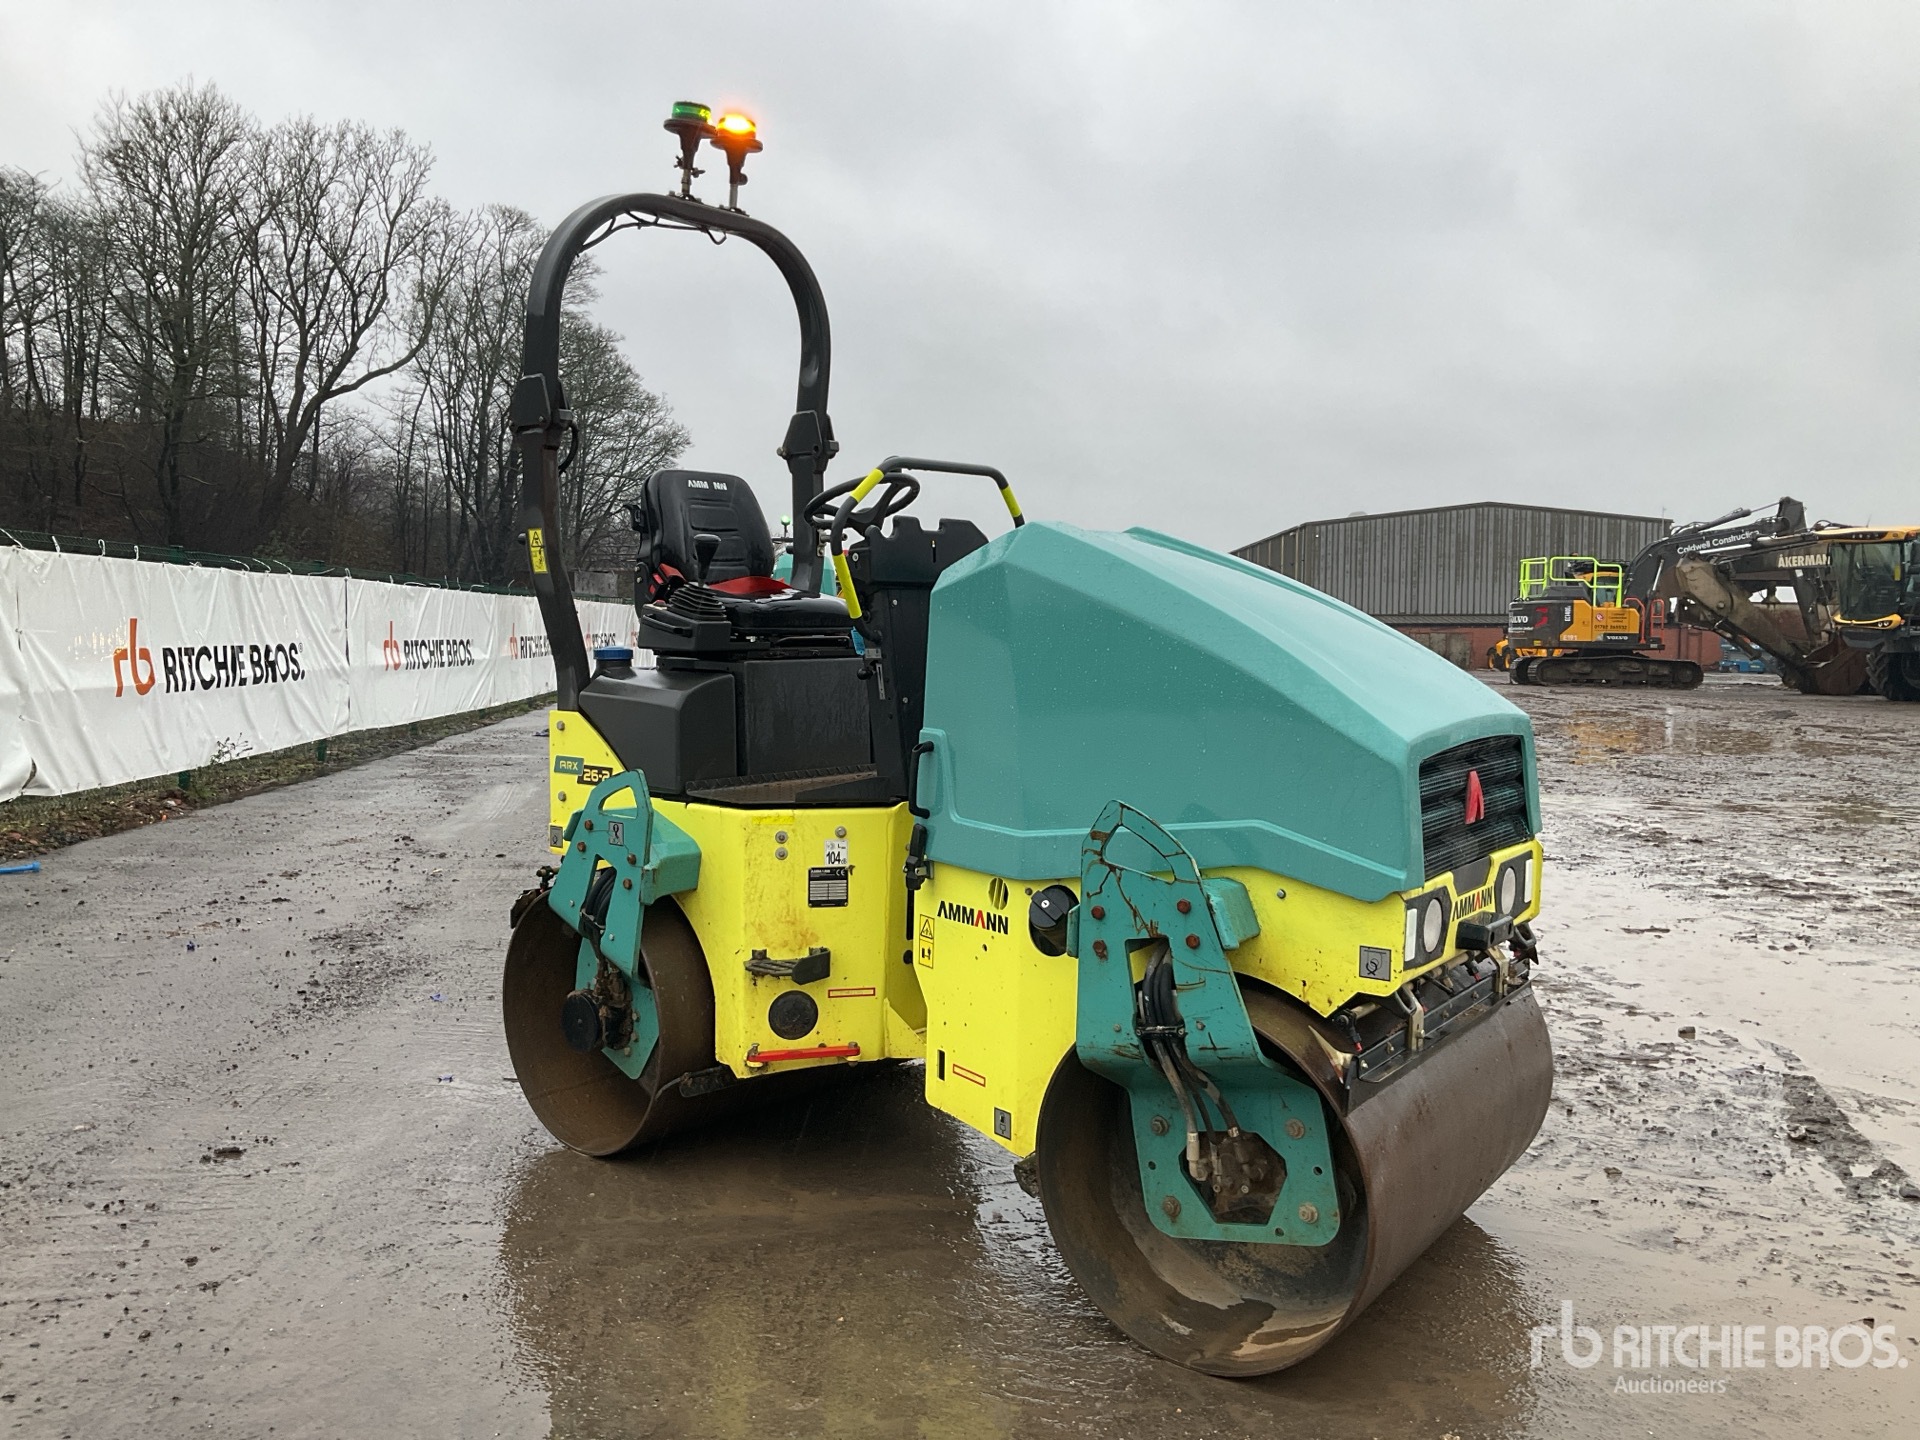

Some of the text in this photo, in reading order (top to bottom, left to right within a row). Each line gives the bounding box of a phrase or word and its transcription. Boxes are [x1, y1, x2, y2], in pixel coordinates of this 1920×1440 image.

[688, 480, 728, 490] AMMNN
[1677, 541, 1711, 555] Caldwell
[113, 618, 156, 697] rb
[162, 646, 248, 693] RITCHIE
[403, 639, 445, 670] RITCHIE
[446, 639, 475, 667] BROS.
[560, 760, 578, 771] ARX
[826, 851, 841, 864] 104
[1452, 886, 1493, 922] AMMANN
[937, 900, 1009, 935] AMMANN
